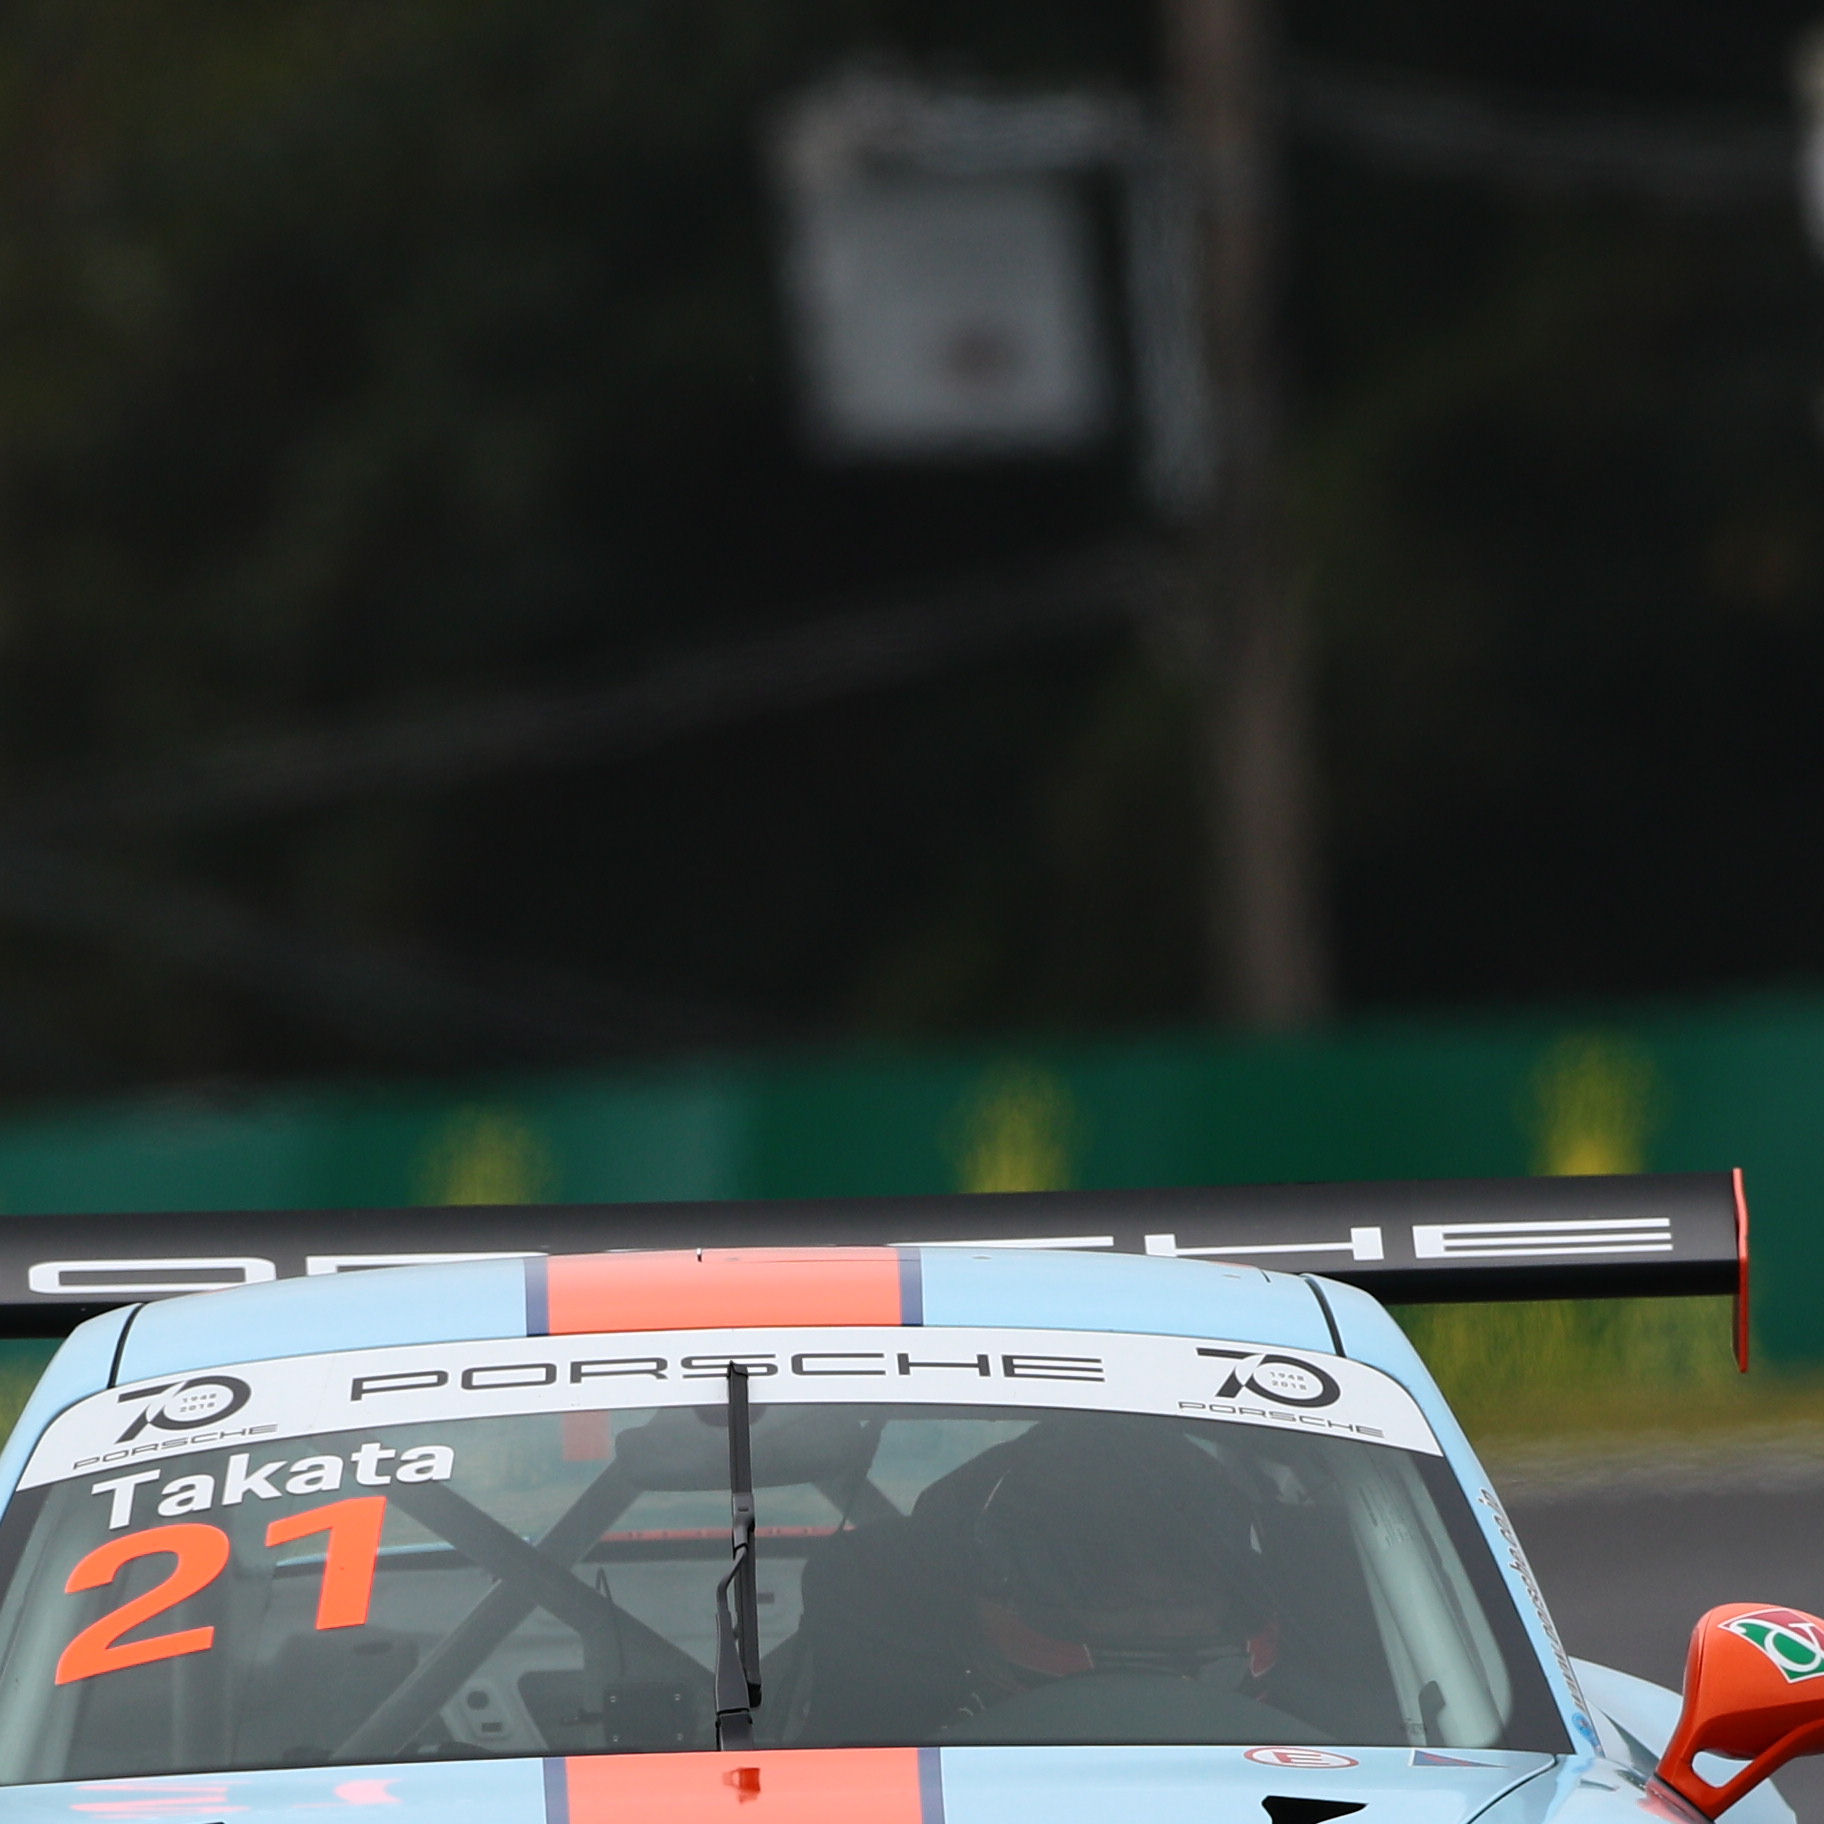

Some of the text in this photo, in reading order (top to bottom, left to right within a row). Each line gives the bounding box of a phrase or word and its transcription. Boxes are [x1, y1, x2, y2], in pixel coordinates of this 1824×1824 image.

[349, 1352, 1106, 1402] PORSCHE
[1195, 1346, 1341, 1409] 70
[115, 1375, 252, 1445] 70
[1178, 1401, 1384, 1439] PORSCHE
[73, 1424, 279, 1470] PORSCHE
[91, 1441, 455, 1531] Takata
[54, 1496, 388, 1686] 21
